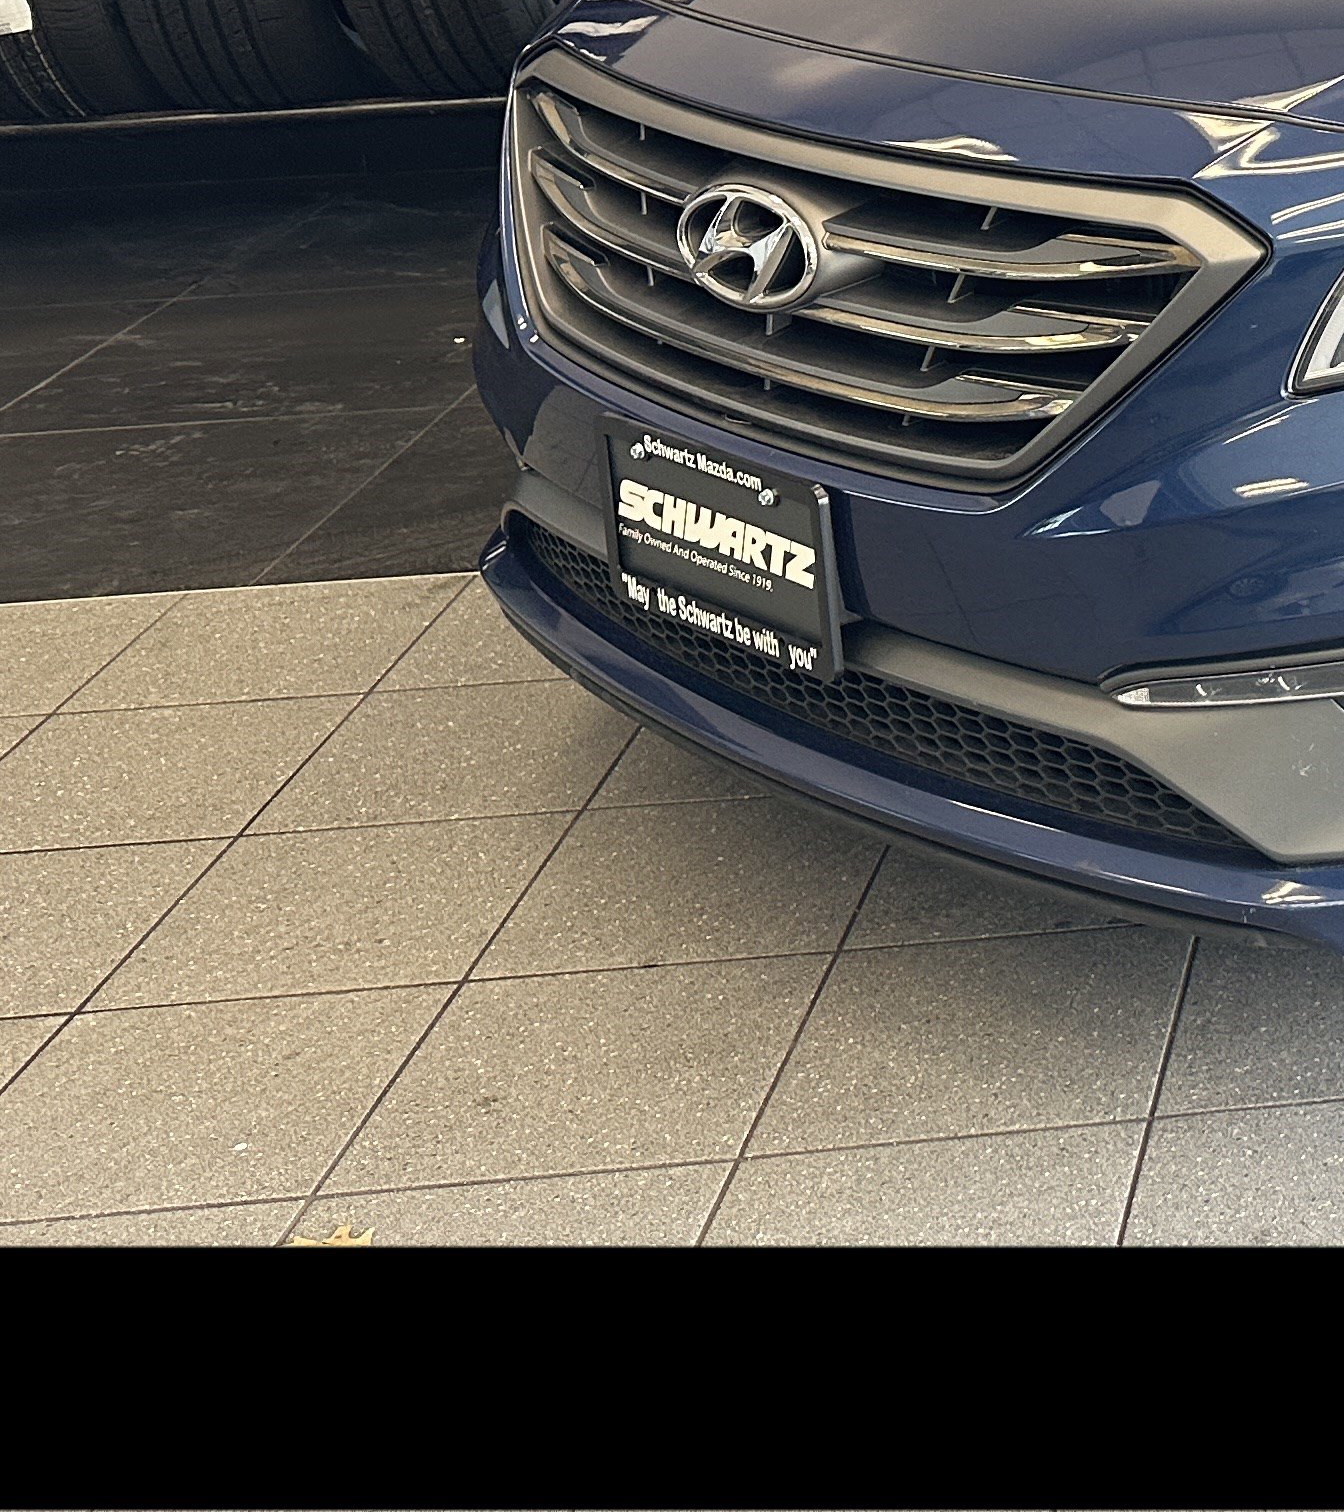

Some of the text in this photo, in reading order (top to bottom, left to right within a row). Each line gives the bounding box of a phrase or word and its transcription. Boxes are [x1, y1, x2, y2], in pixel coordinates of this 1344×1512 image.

[644, 434, 762, 491] Schwartz Mazda.com
[618, 479, 815, 589] SCHWARTZ
[618, 523, 773, 592] Family Owned And Operated Since 1919.
[621, 572, 817, 670] "May the Schwartz be with you"
